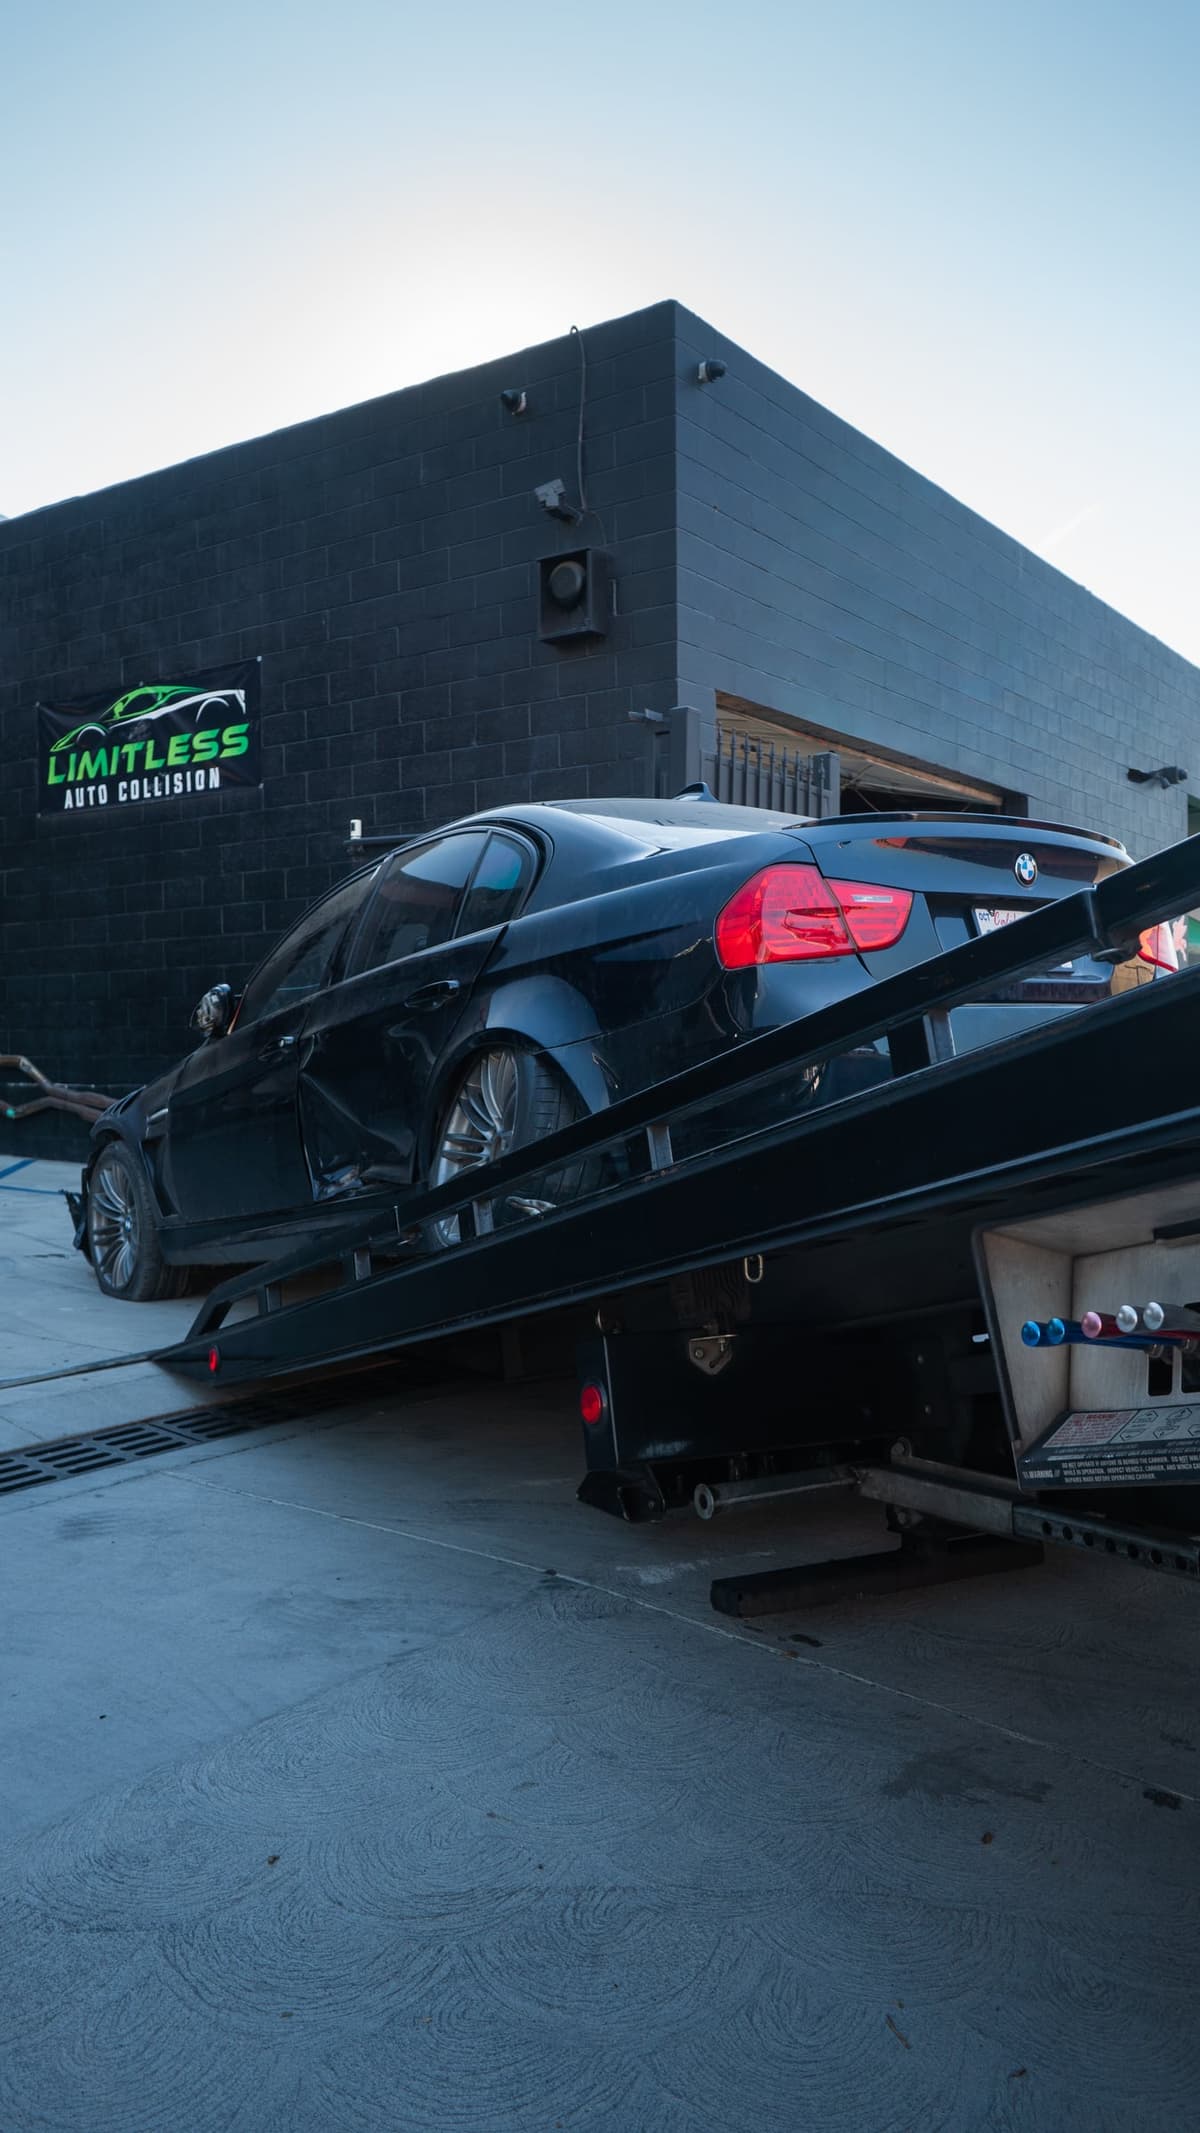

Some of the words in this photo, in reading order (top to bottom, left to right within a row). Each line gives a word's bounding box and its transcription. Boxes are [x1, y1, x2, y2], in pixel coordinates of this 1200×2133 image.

[47, 723, 250, 785] LIMITLESS
[64, 784, 108, 810] AUTO
[118, 767, 221, 802] COLLISION
[978, 911, 991, 921] OCT
